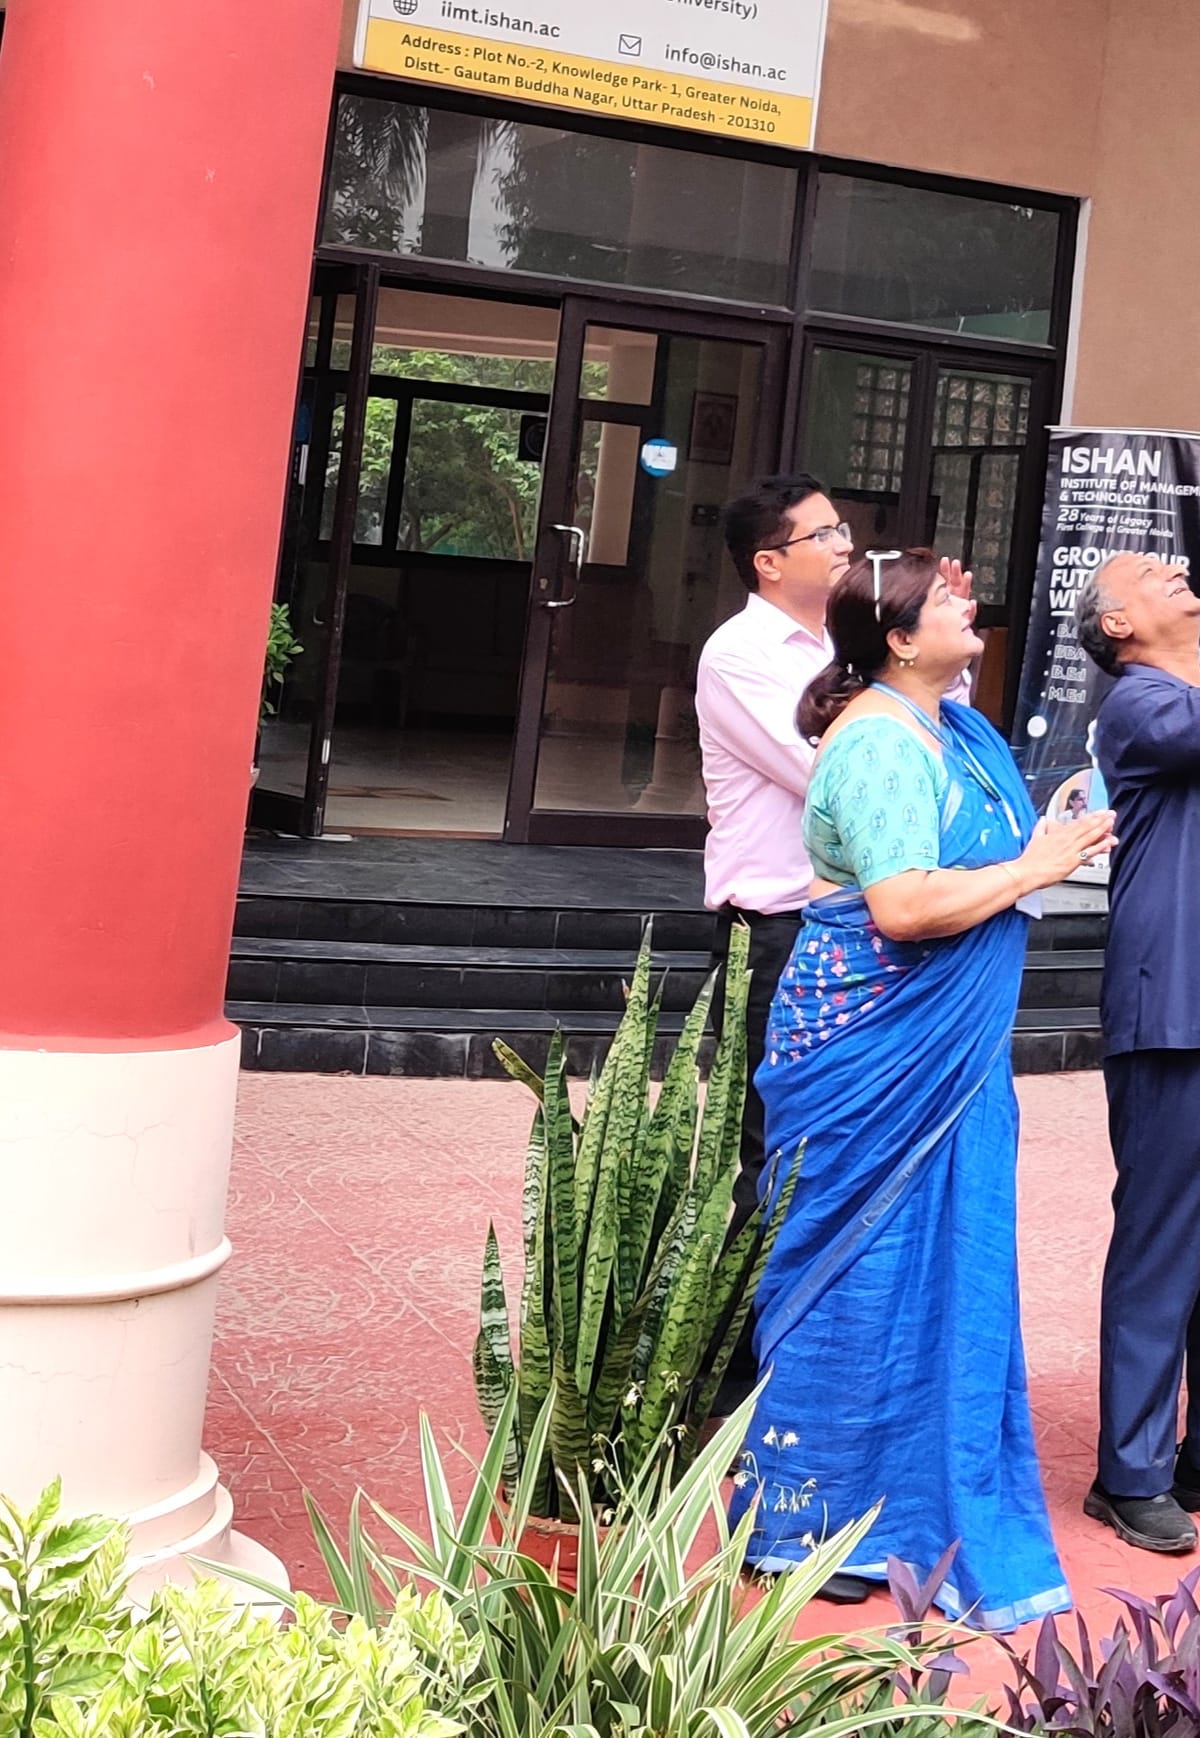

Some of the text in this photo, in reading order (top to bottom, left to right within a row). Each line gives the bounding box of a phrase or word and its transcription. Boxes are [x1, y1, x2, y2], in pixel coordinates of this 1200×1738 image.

[441, 1, 561, 38] iimt.ishan.ac
[401, 34, 462, 56] Address
[473, 47, 502, 63] Plot
[506, 53, 548, 74] No.-2,
[552, 62, 629, 87] Knowledge
[686, 86, 736, 105] Greater
[740, 97, 782, 115] Noida,
[665, 44, 787, 81] info@ishan.ac
[454, 66, 511, 86] Gautam
[515, 77, 569, 97] Buddha
[573, 87, 617, 108] Nagar,
[622, 95, 658, 112] Uttar
[661, 103, 716, 123] Pradesh
[727, 114, 776, 133] 201310
[1061, 446, 1162, 477] ISHAN
[1059, 490, 1150, 505] & TECHNOLOGY
[1060, 478, 1118, 490] INSTITUTE
[1120, 480, 1137, 491] OF
[1056, 522, 1074, 531] First
[1075, 523, 1105, 534] College
[1117, 525, 1148, 536] Greater
[1057, 508, 1153, 528] 28 Years of Legacy
